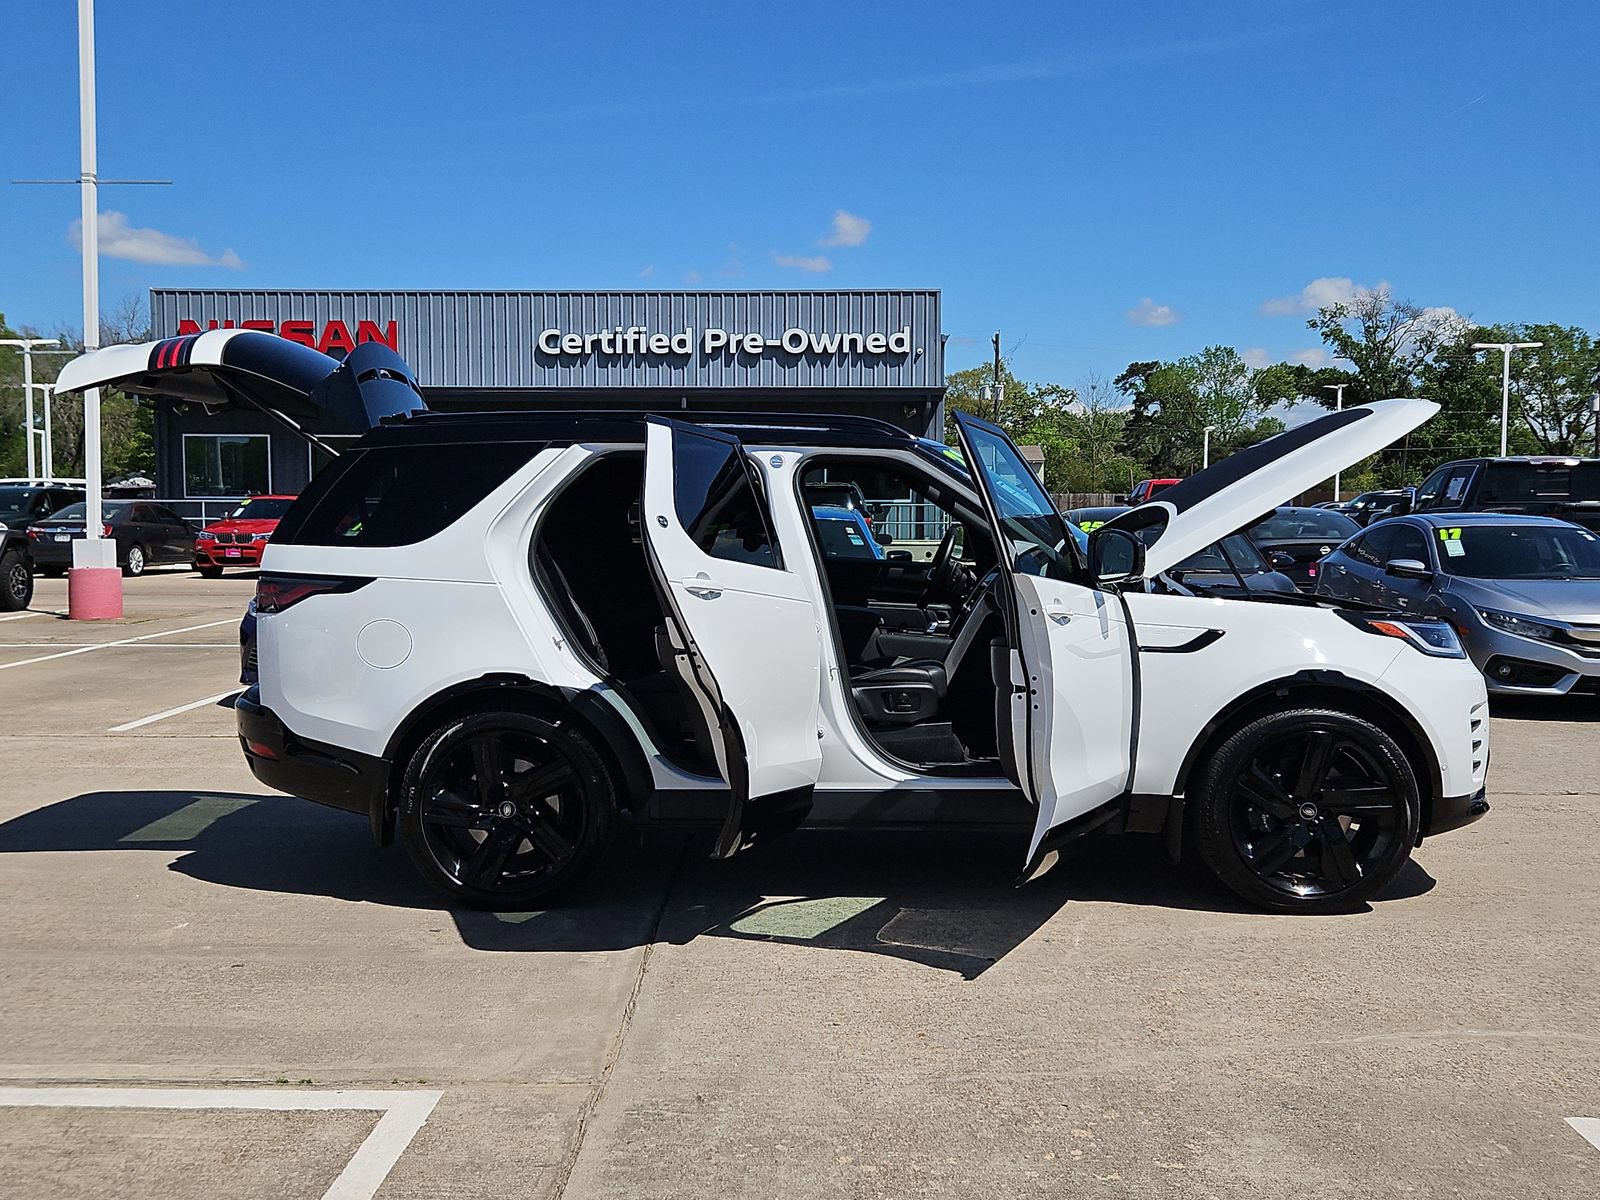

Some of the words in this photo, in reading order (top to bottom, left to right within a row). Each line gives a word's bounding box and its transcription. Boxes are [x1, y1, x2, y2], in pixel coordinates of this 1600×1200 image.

[179, 320, 398, 353] SAN
[538, 326, 693, 354] Certified
[704, 326, 911, 354] Pre-Owned
[1439, 528, 1462, 540] 17
